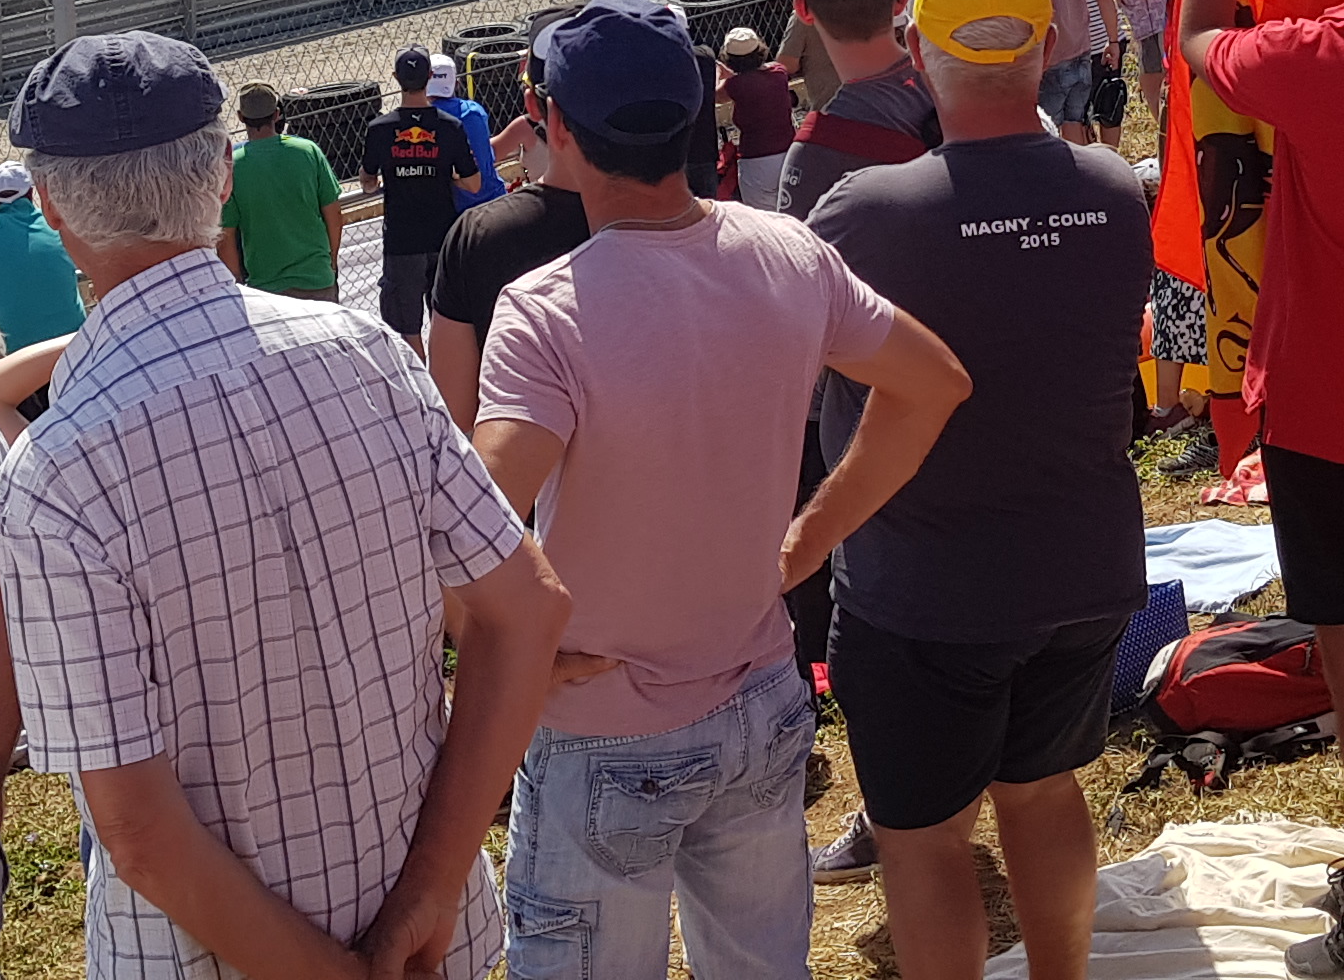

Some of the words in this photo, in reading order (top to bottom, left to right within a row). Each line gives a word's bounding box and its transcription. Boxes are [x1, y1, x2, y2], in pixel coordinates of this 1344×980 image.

[391, 145, 415, 158] Red
[416, 146, 440, 158] Bull
[396, 166, 423, 177] Mobil
[960, 218, 1030, 237] MAGNY
[1048, 211, 1108, 227] COURS
[1019, 233, 1060, 249] 2015
